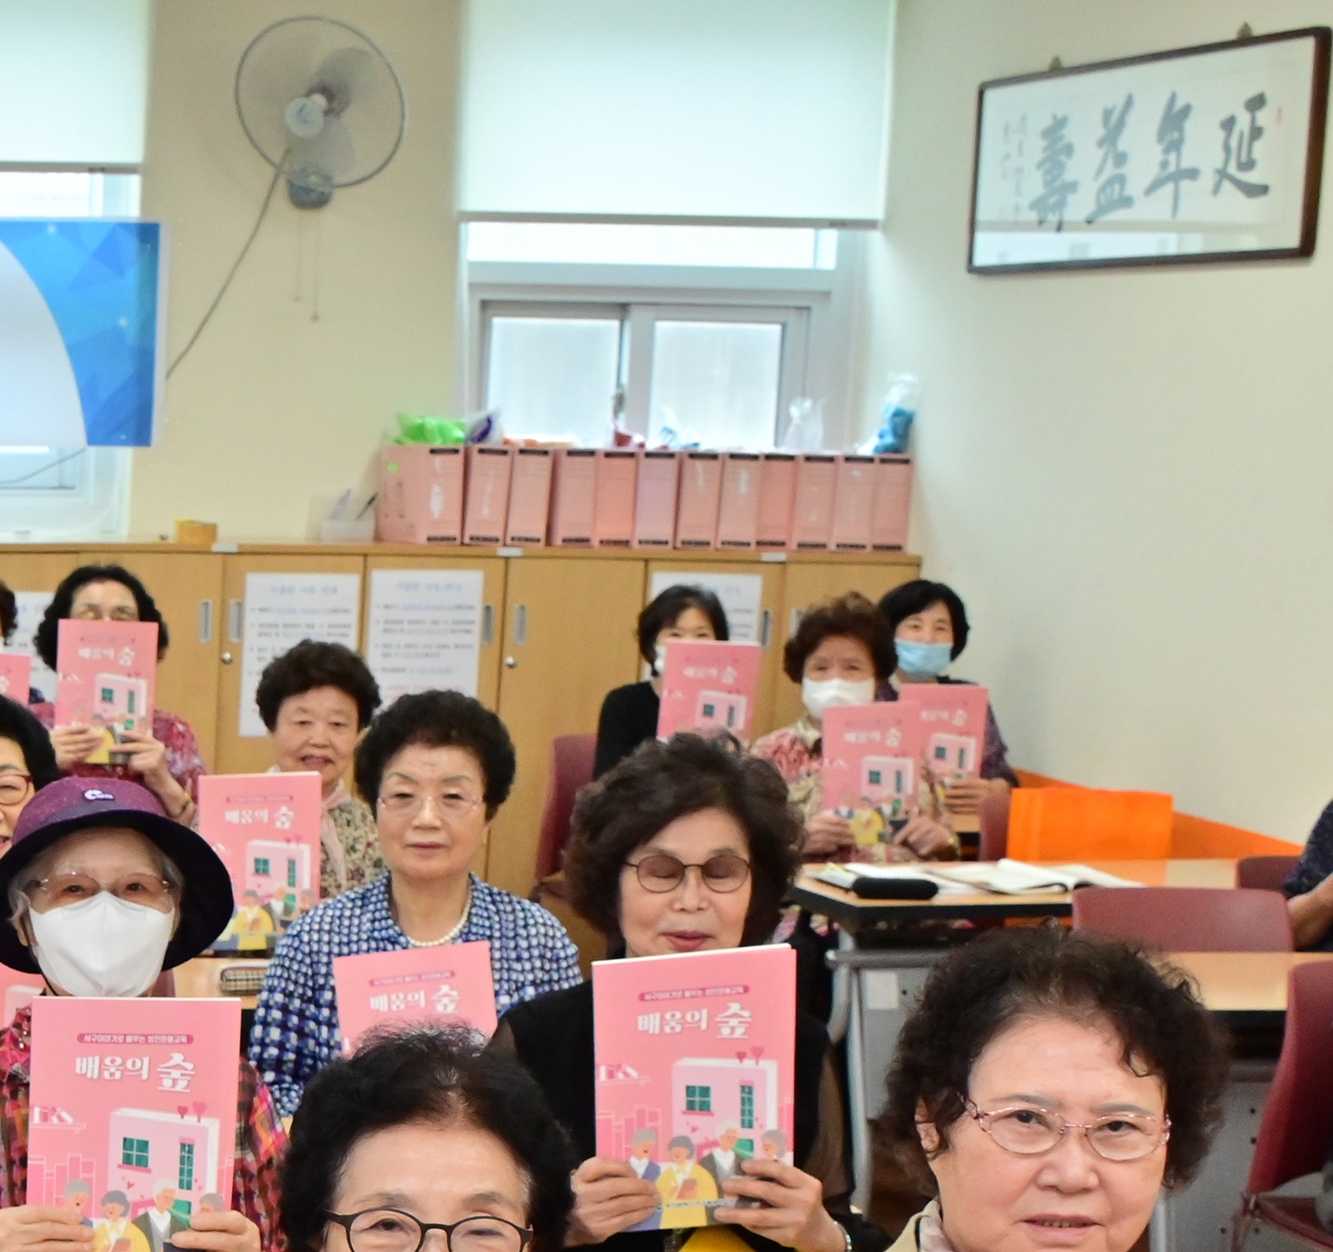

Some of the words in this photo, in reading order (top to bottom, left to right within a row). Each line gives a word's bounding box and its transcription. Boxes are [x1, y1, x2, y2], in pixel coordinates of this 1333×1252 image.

[638, 1007, 709, 1035] 배움의
[715, 1002, 753, 1039] 숲
[75, 1055, 150, 1080] 배움의
[157, 1052, 196, 1092] 숲
